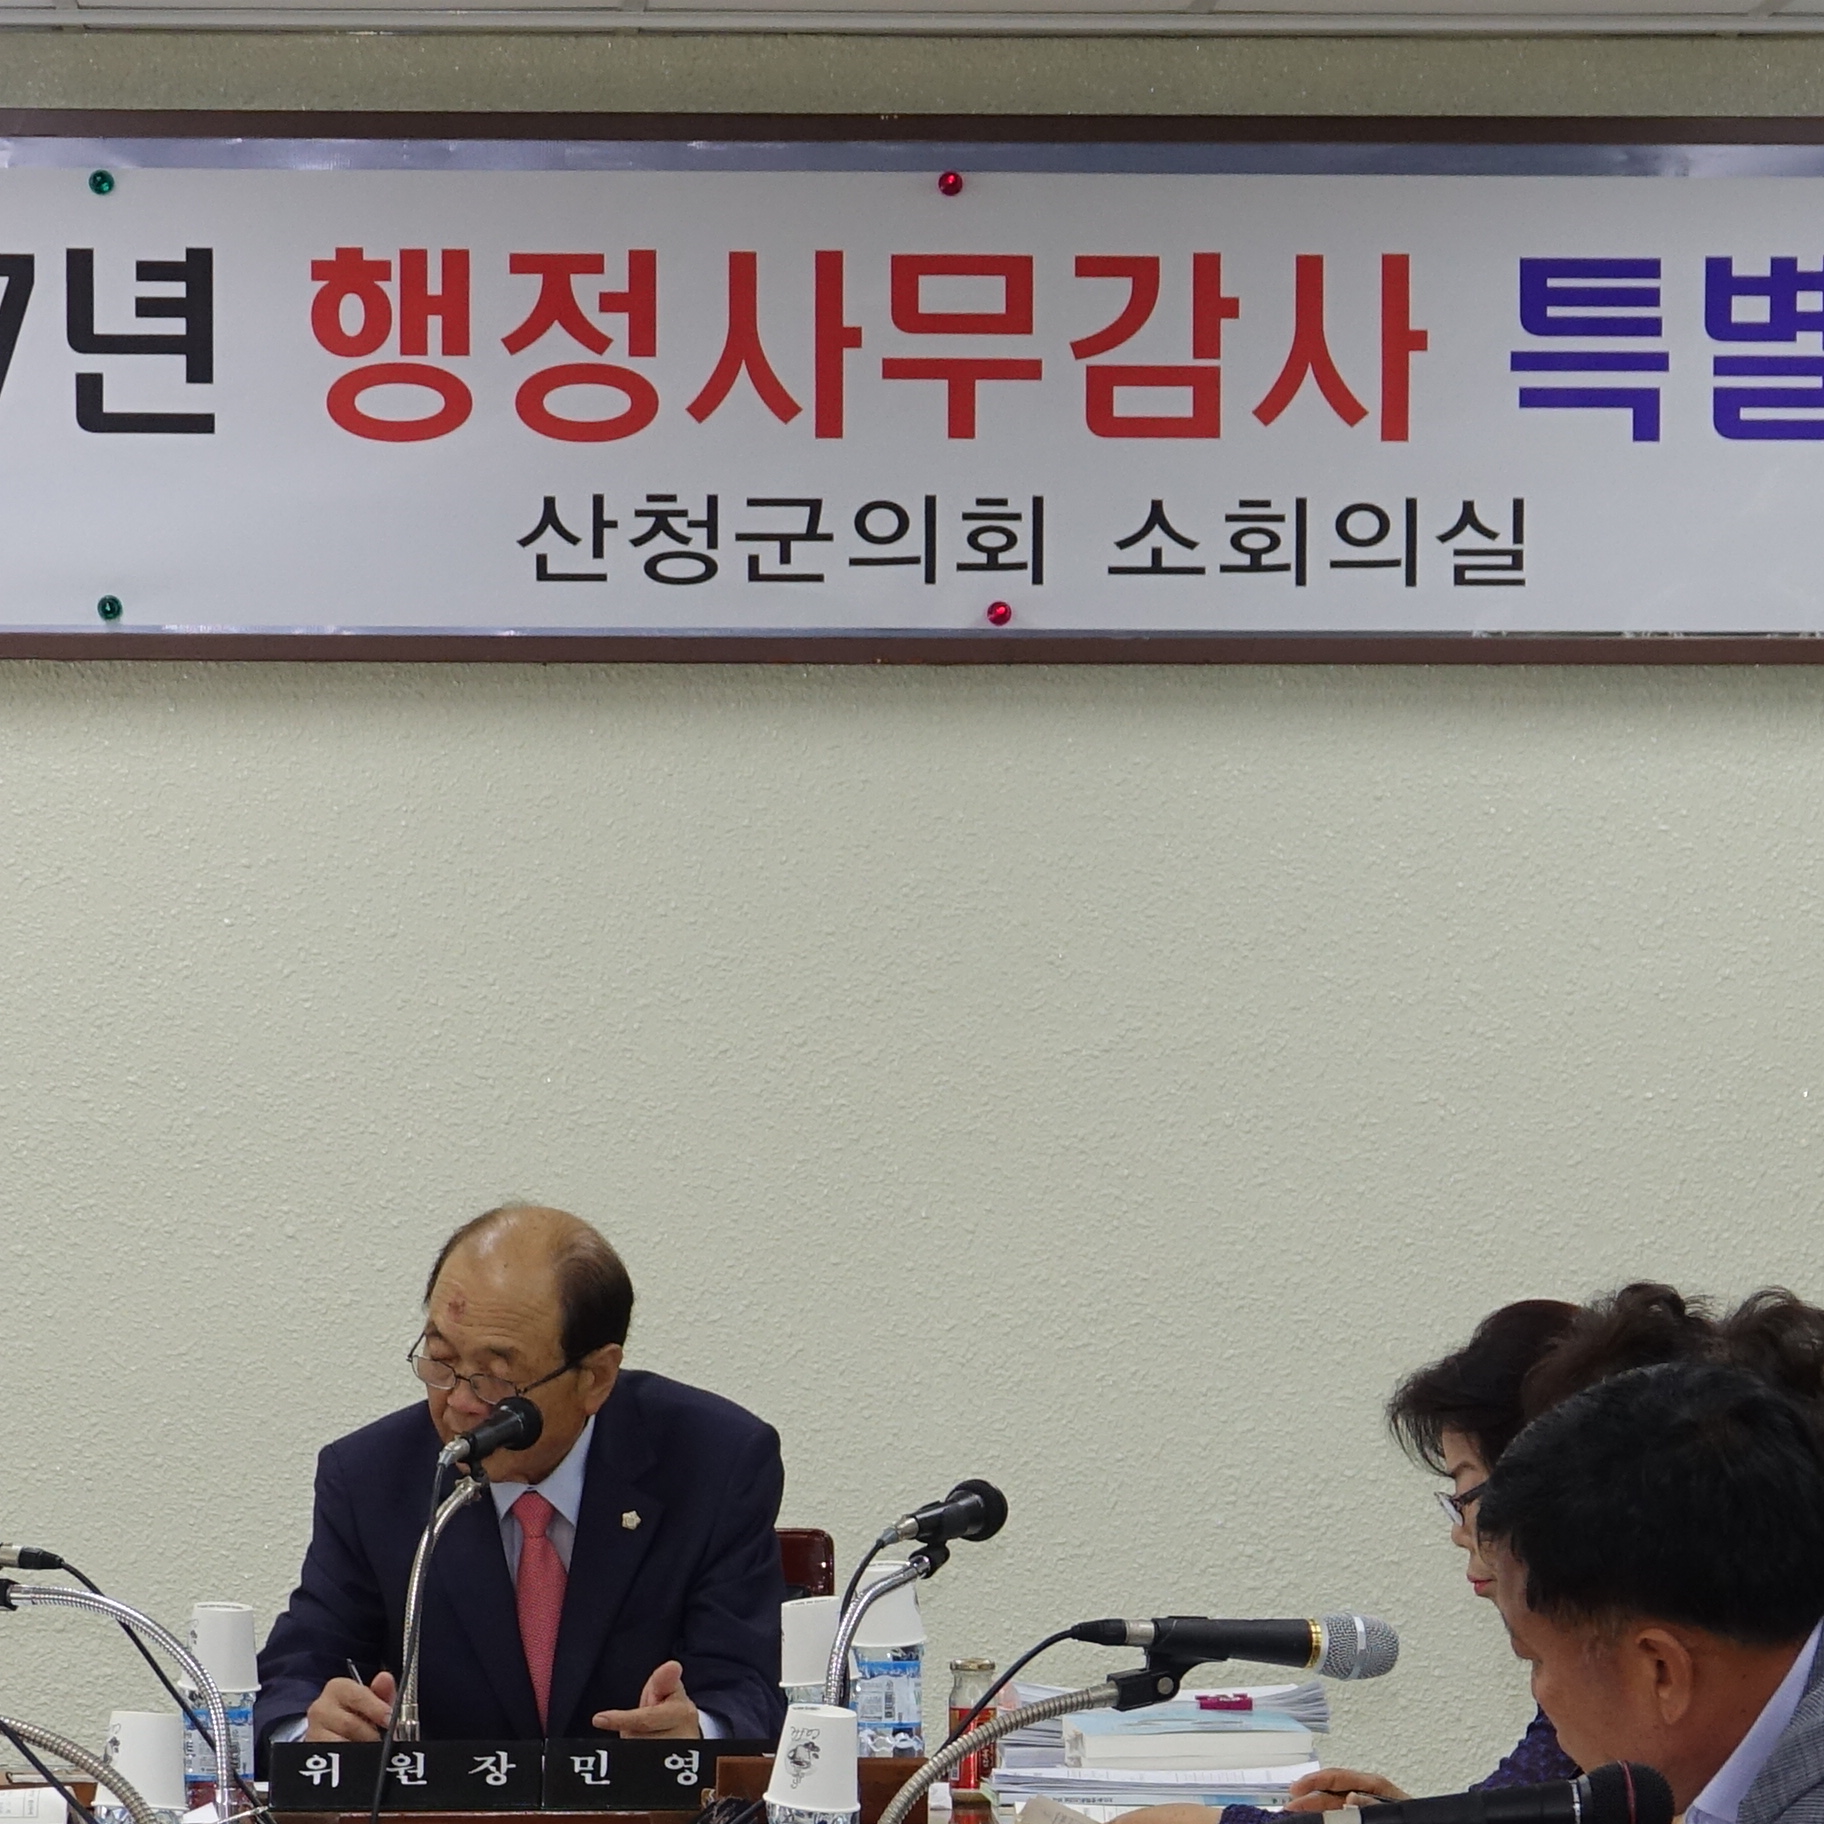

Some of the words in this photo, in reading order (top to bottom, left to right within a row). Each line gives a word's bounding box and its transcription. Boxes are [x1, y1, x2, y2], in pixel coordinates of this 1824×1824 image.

[311, 248, 1427, 443] 행정사무감사
[519, 494, 1044, 586] 산청군의회
[1108, 498, 1526, 588] 소회의실
[298, 1750, 517, 1788] 위원장
